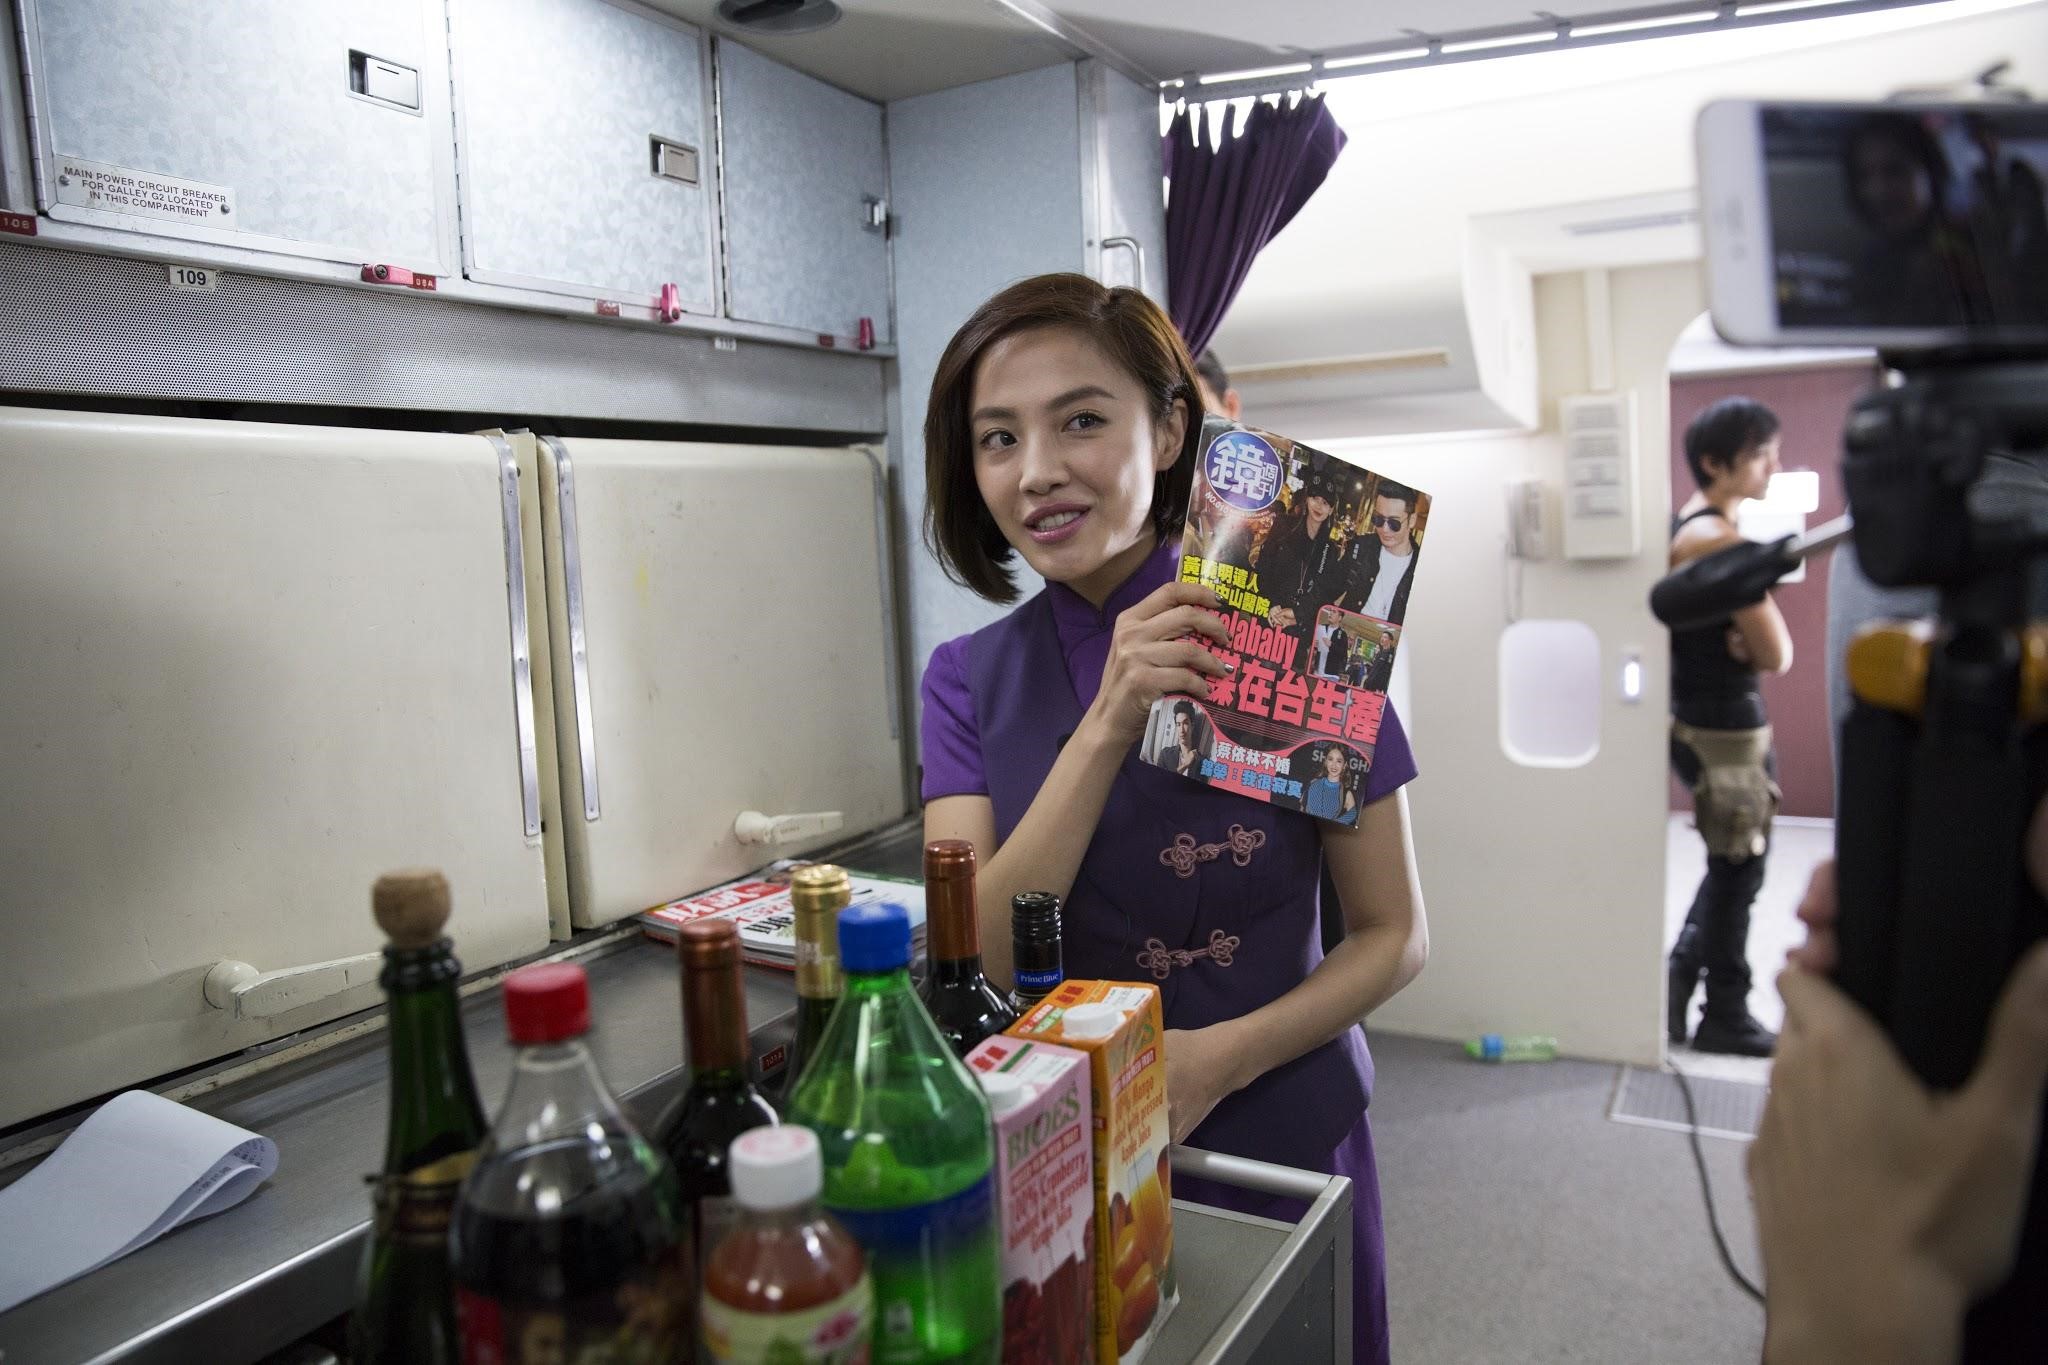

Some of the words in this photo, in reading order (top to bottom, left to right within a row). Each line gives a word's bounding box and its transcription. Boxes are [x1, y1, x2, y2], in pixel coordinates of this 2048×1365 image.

[64, 166, 93, 179] MAIN
[96, 172, 134, 187] POWER
[138, 180, 179, 195] CIRCUIT
[182, 189, 226, 203] BREAKER
[82, 180, 104, 190] FOR
[108, 184, 147, 198] GALLEY
[151, 191, 164, 201] G2
[168, 195, 213, 210] LOCATED
[89, 190, 101, 200] IN
[104, 193, 129, 205] THIS
[132, 198, 209, 218] COMPARTMENT
[176, 269, 206, 285] 109
[1020, 975, 1042, 984] Prime
[1043, 973, 1059, 983] Blue
